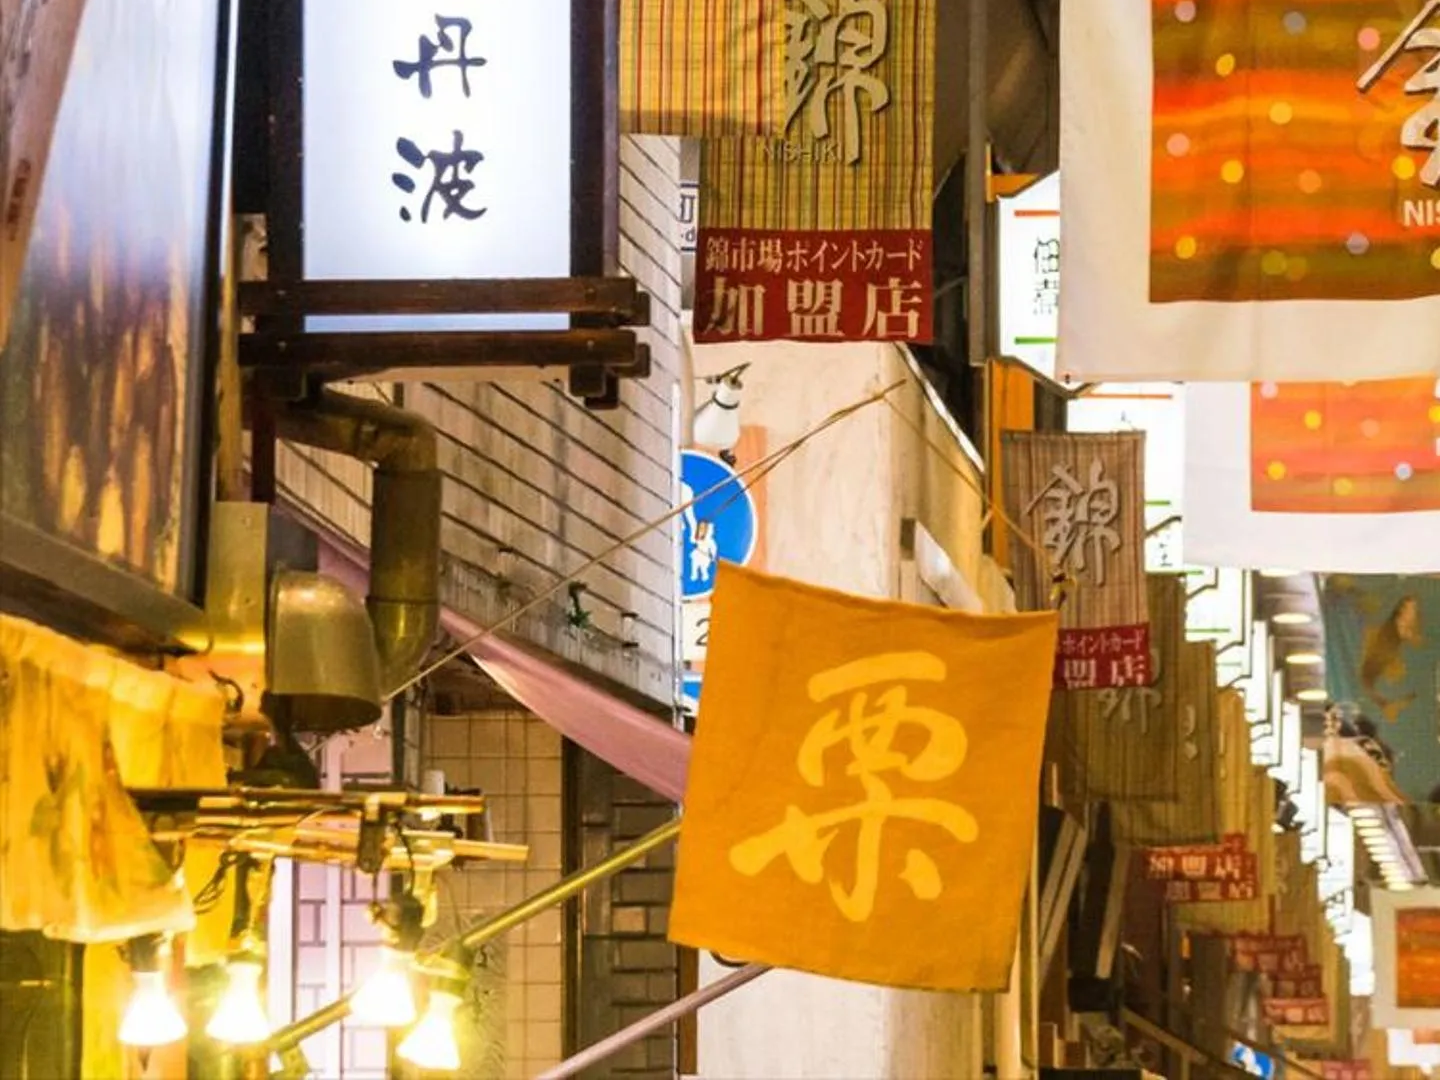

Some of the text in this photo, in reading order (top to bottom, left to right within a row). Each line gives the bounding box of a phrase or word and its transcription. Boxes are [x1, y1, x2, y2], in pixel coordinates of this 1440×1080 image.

[705, 236, 923, 274] 錦市場ポイントカード
[703, 275, 924, 338] 加盟店
[1027, 457, 1121, 588] 錦
[729, 651, 980, 922] 栗
